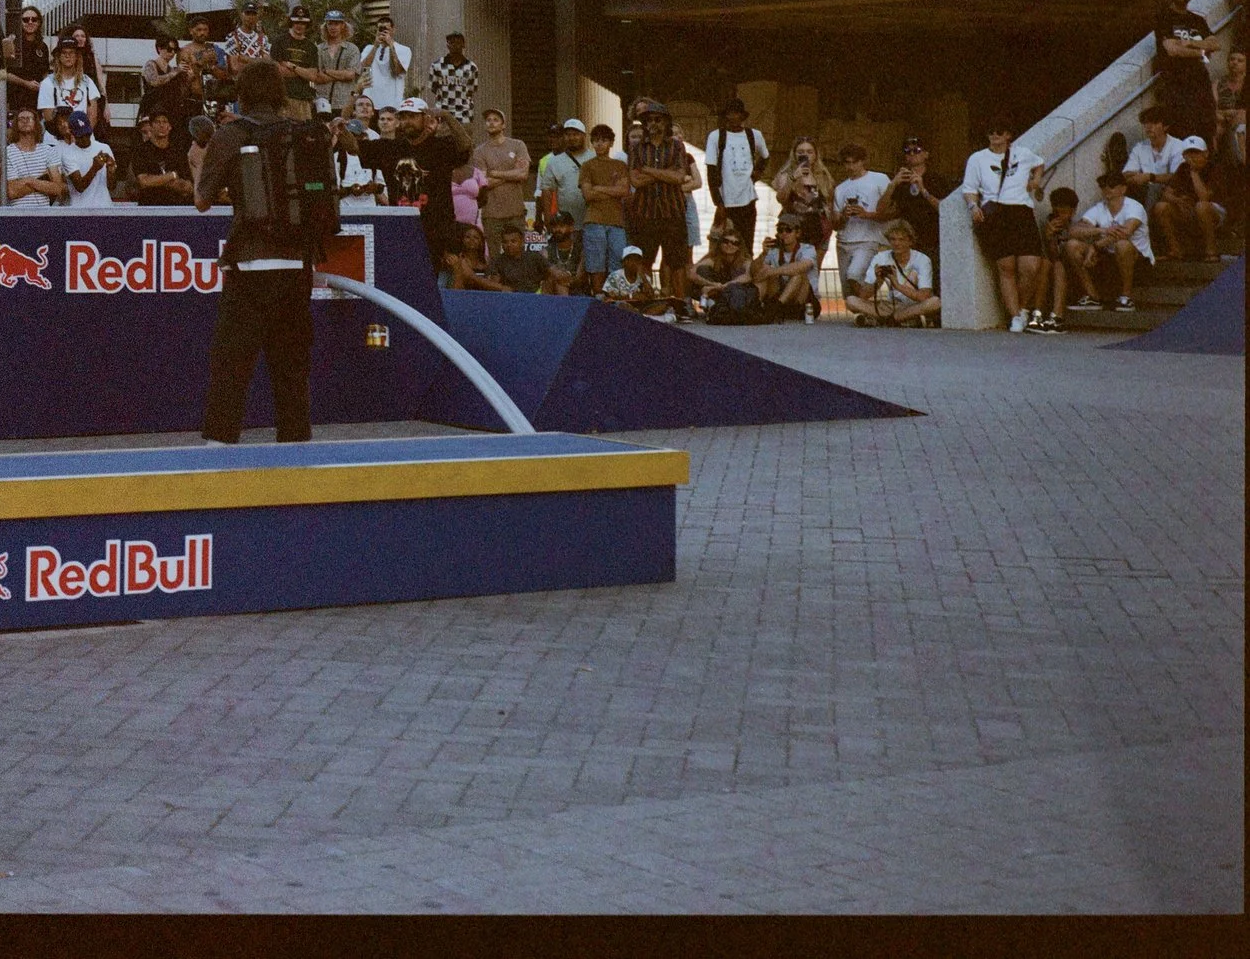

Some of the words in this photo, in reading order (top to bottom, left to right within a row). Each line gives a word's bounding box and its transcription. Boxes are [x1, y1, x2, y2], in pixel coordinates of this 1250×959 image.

[67, 241, 155, 291] Red
[161, 241, 226, 291] Bu
[27, 541, 120, 600] Red
[125, 535, 212, 595] Bull
